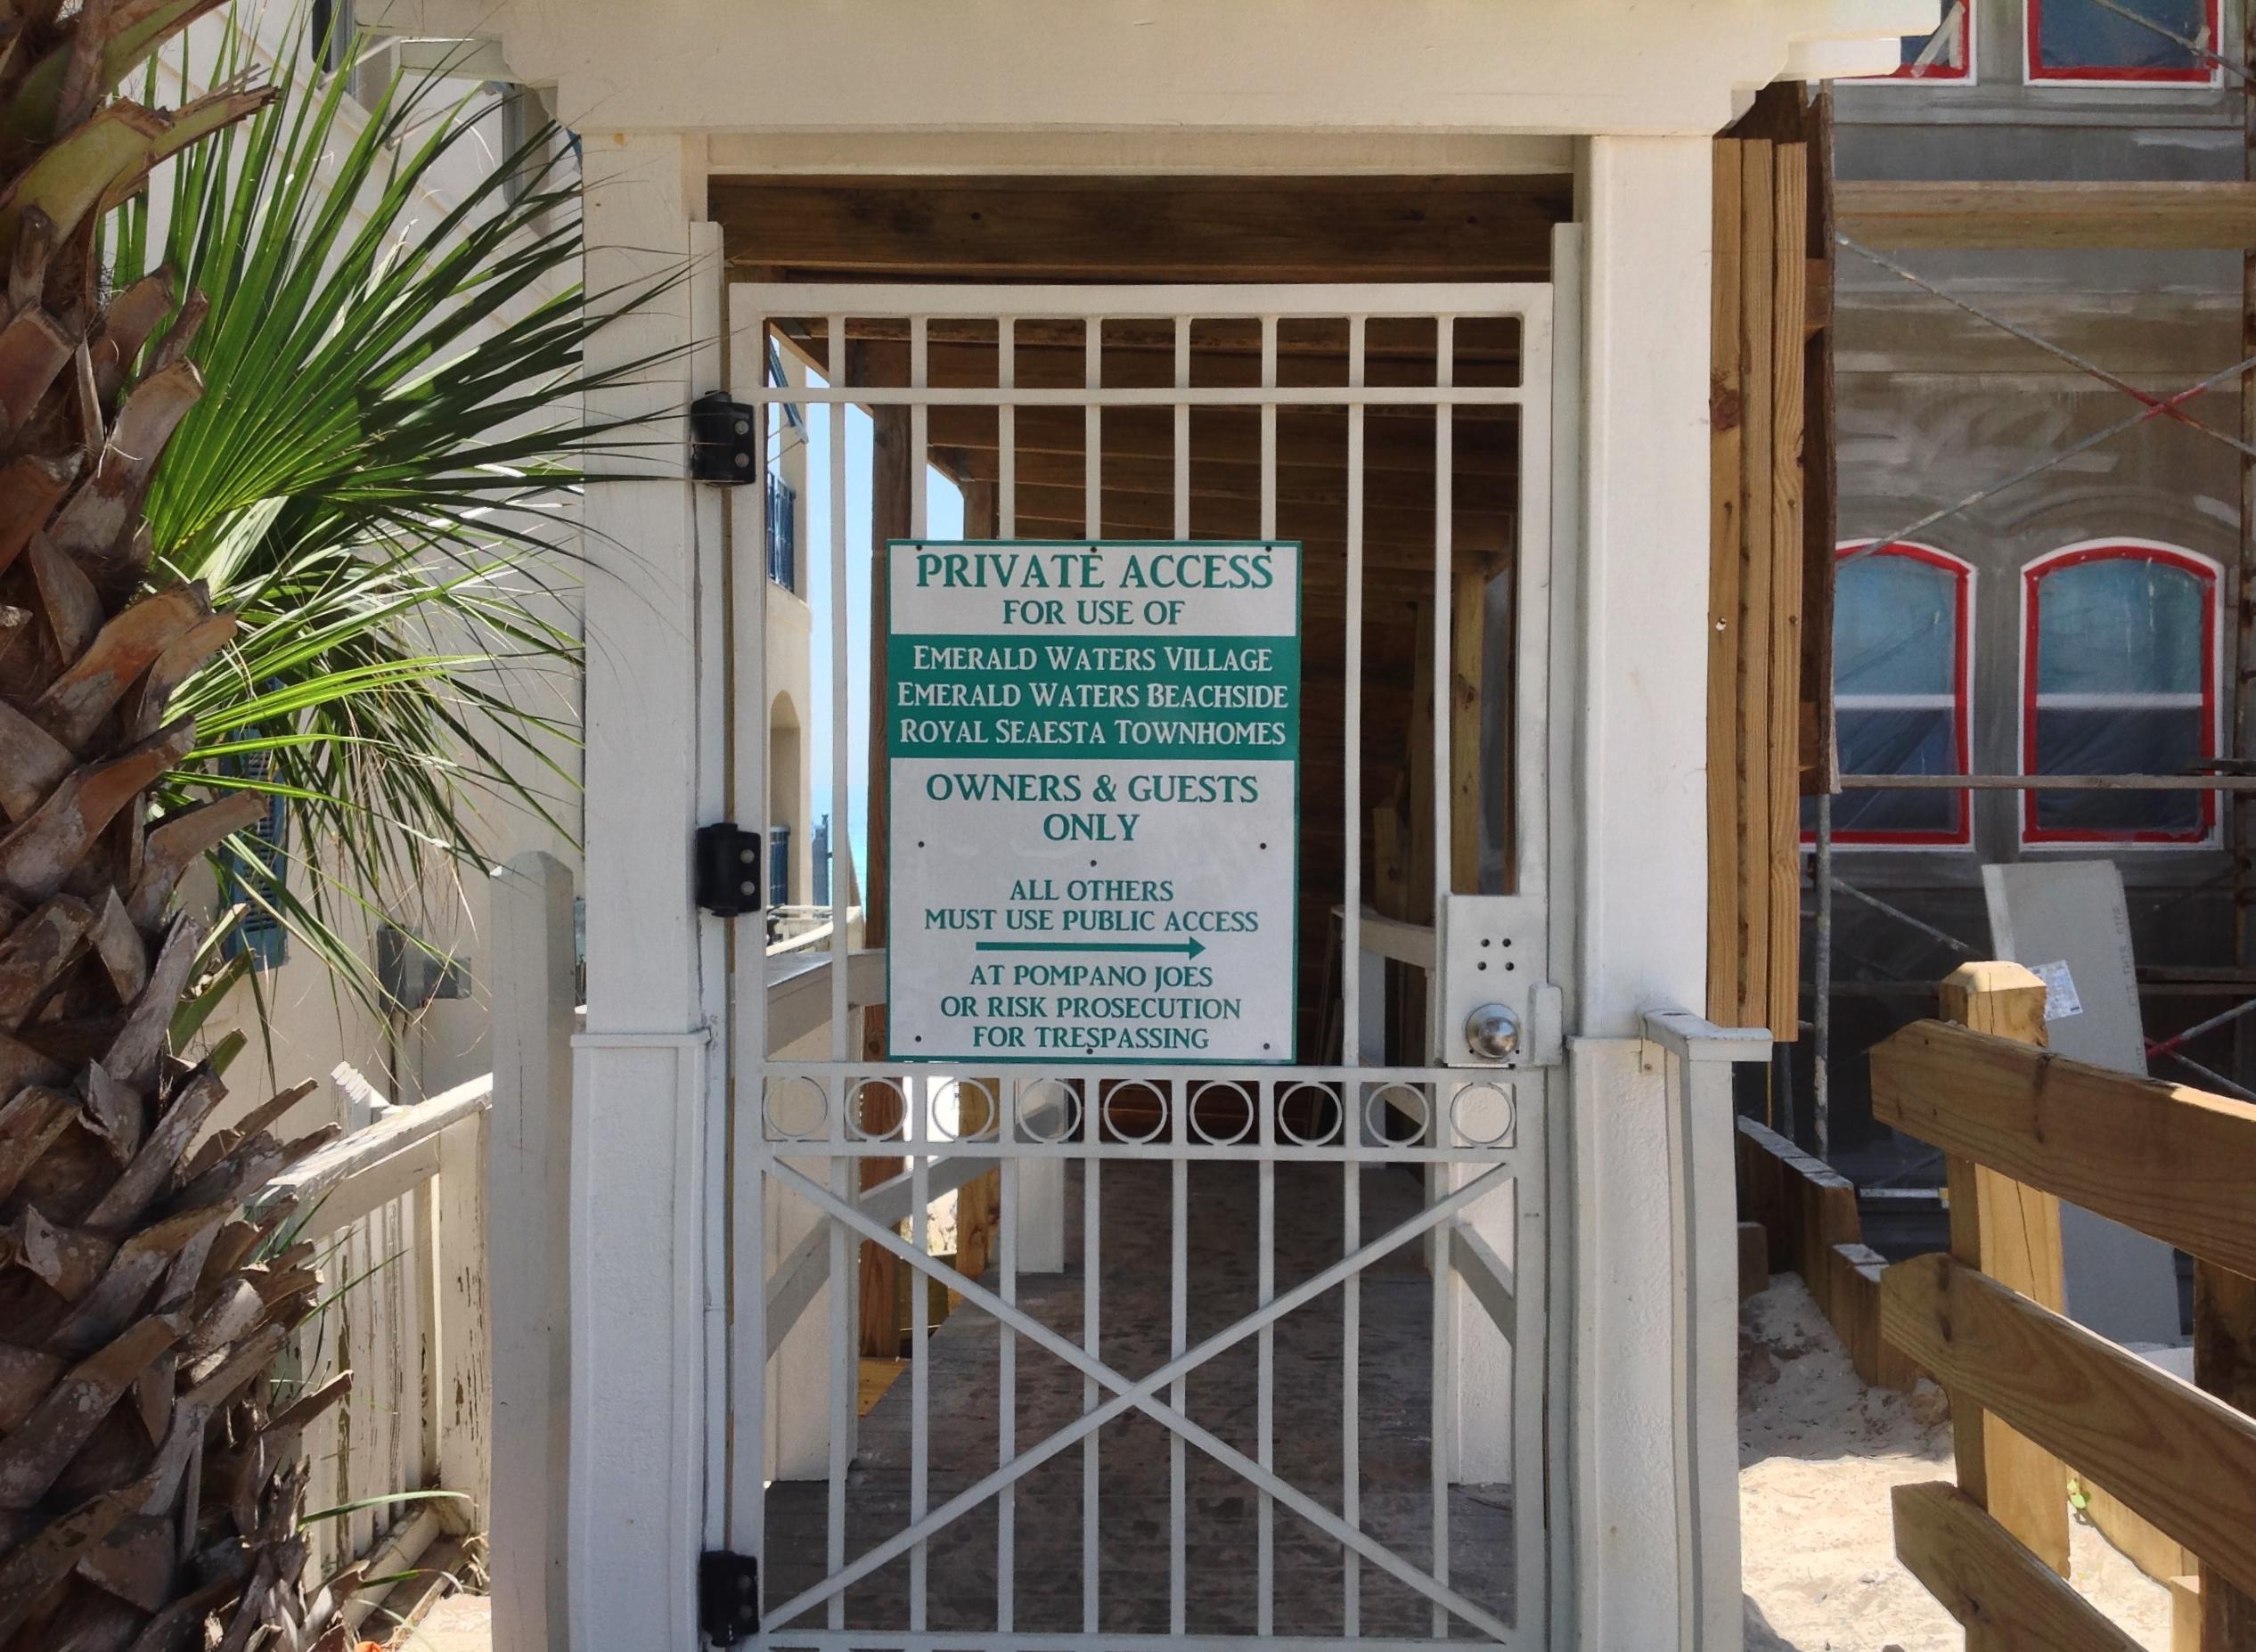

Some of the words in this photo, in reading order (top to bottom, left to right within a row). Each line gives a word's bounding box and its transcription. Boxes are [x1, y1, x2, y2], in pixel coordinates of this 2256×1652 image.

[917, 554, 1104, 588] PRIVATE
[1119, 555, 1272, 589] ACCESS
[1003, 600, 1066, 625] FOR
[1077, 601, 1133, 625] USE
[1144, 601, 1184, 625] OF
[914, 645, 1037, 670] EMERALD
[1045, 646, 1156, 670] WATERS
[1164, 647, 1272, 671] VILLAGE
[898, 683, 1020, 706] EMERALD
[1029, 683, 1140, 707] WATERS
[1148, 683, 1287, 707] BEACHSIDE
[901, 719, 988, 742] ROYAL
[996, 719, 1106, 743] SEAESTA
[1115, 720, 1286, 745] TOWNHOMES
[927, 774, 1081, 801] OWNERS
[1093, 775, 1116, 802] &
[1129, 776, 1257, 803] GUESTS
[1043, 814, 1139, 840] ONLY
[1010, 879, 1059, 900] ALL
[1067, 880, 1173, 901] OTHERS
[926, 909, 996, 929] MUST
[1007, 910, 1053, 930] USE
[1063, 910, 1155, 931] PUBLIC
[1165, 912, 1258, 931] ACCESS
[970, 965, 1005, 985] AT
[1014, 965, 1146, 986] POMPANO
[1155, 967, 1212, 993] JOES
[941, 996, 978, 1017] OR
[988, 997, 1047, 1017] RISK
[1057, 997, 1240, 1018] PROSECUTION
[974, 1026, 1026, 1047] FOR
[1034, 1027, 1208, 1049] TRESPASSING
